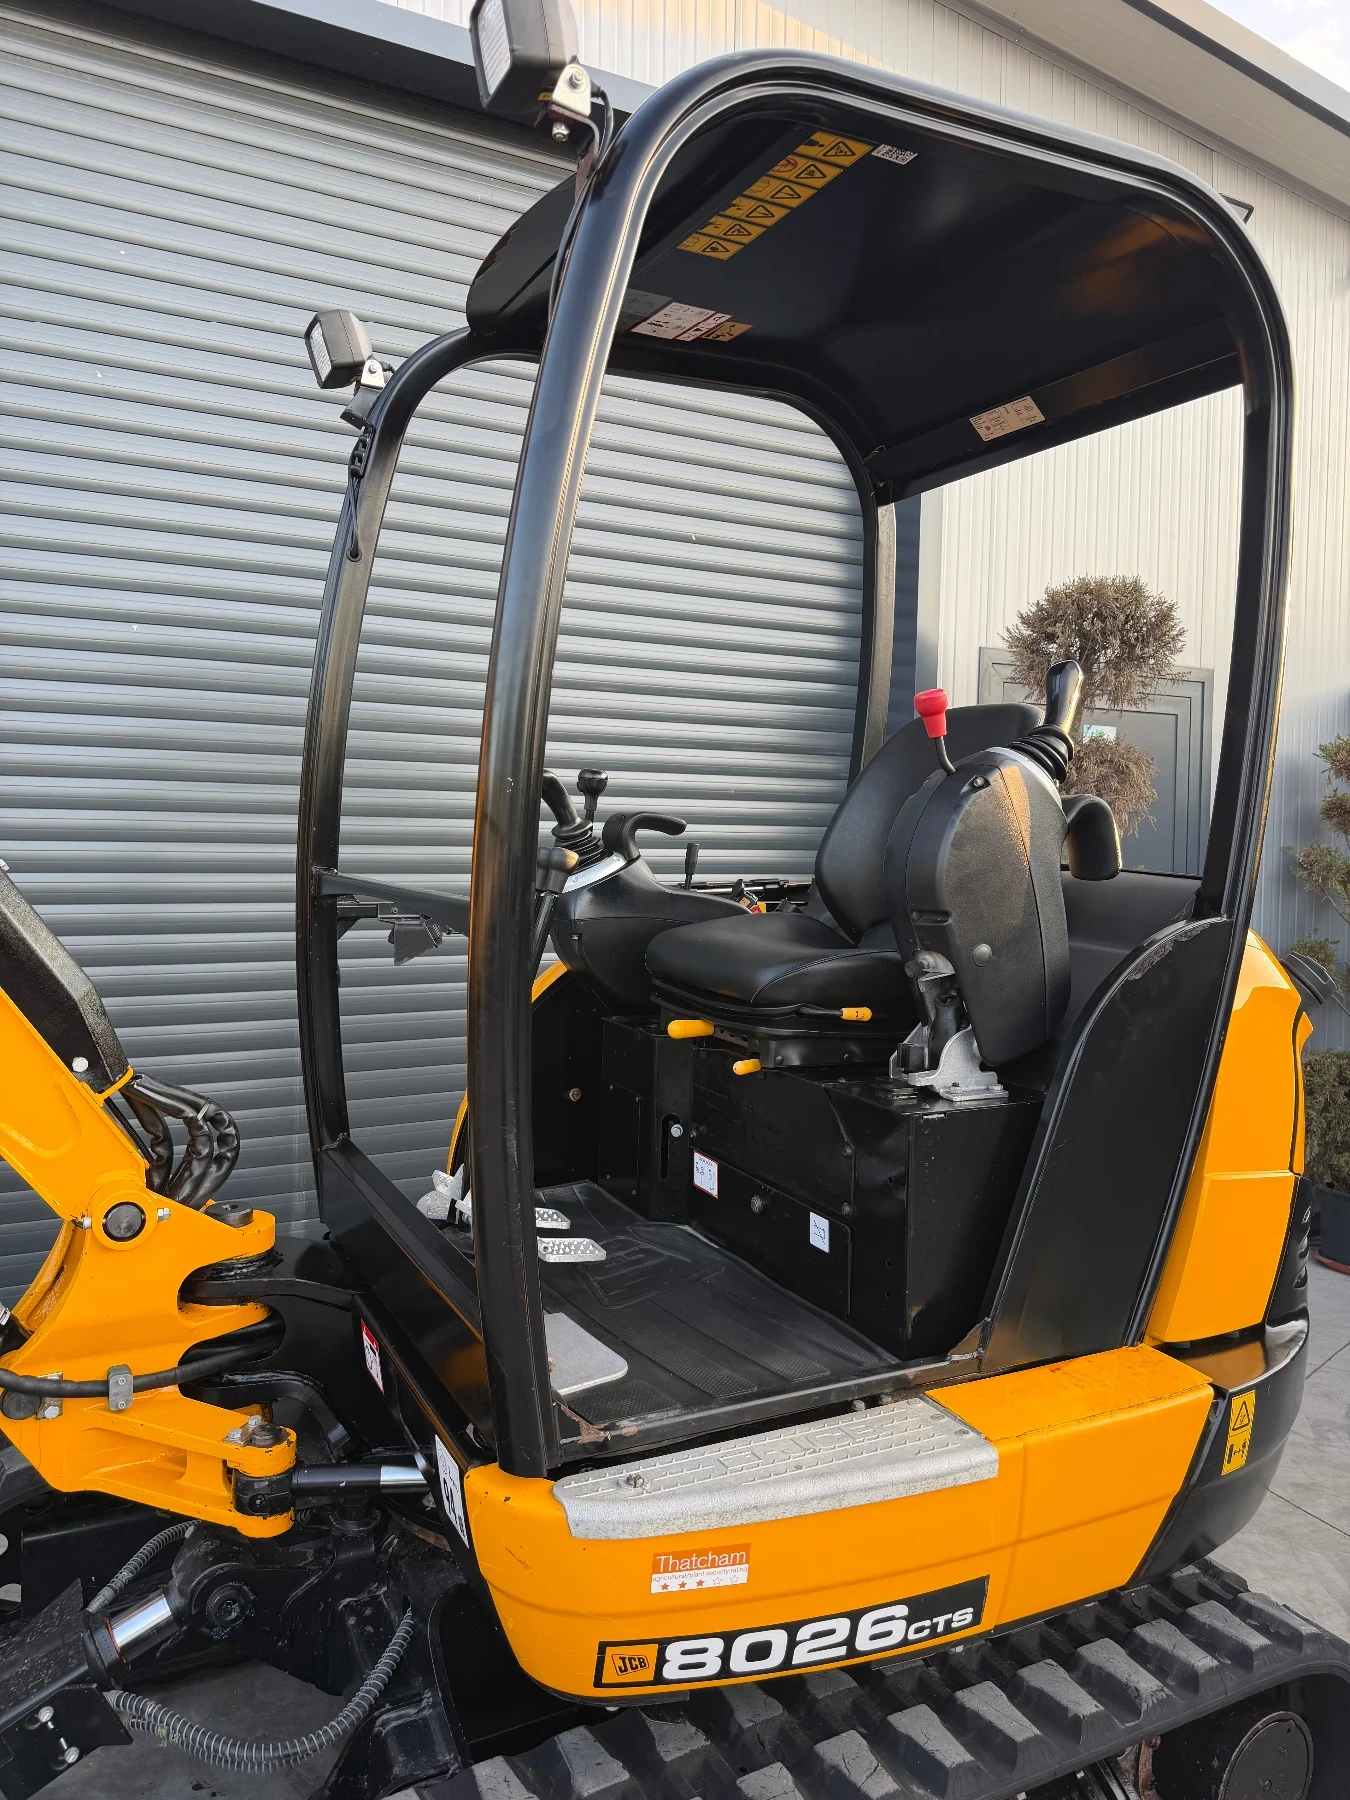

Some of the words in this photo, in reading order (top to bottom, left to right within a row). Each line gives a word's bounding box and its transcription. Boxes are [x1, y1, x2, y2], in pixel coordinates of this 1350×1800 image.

[656, 1551, 746, 1572] Thatcham
[706, 1567, 730, 1577] security
[730, 1566, 748, 1574] rating
[617, 1656, 648, 1673] JCB
